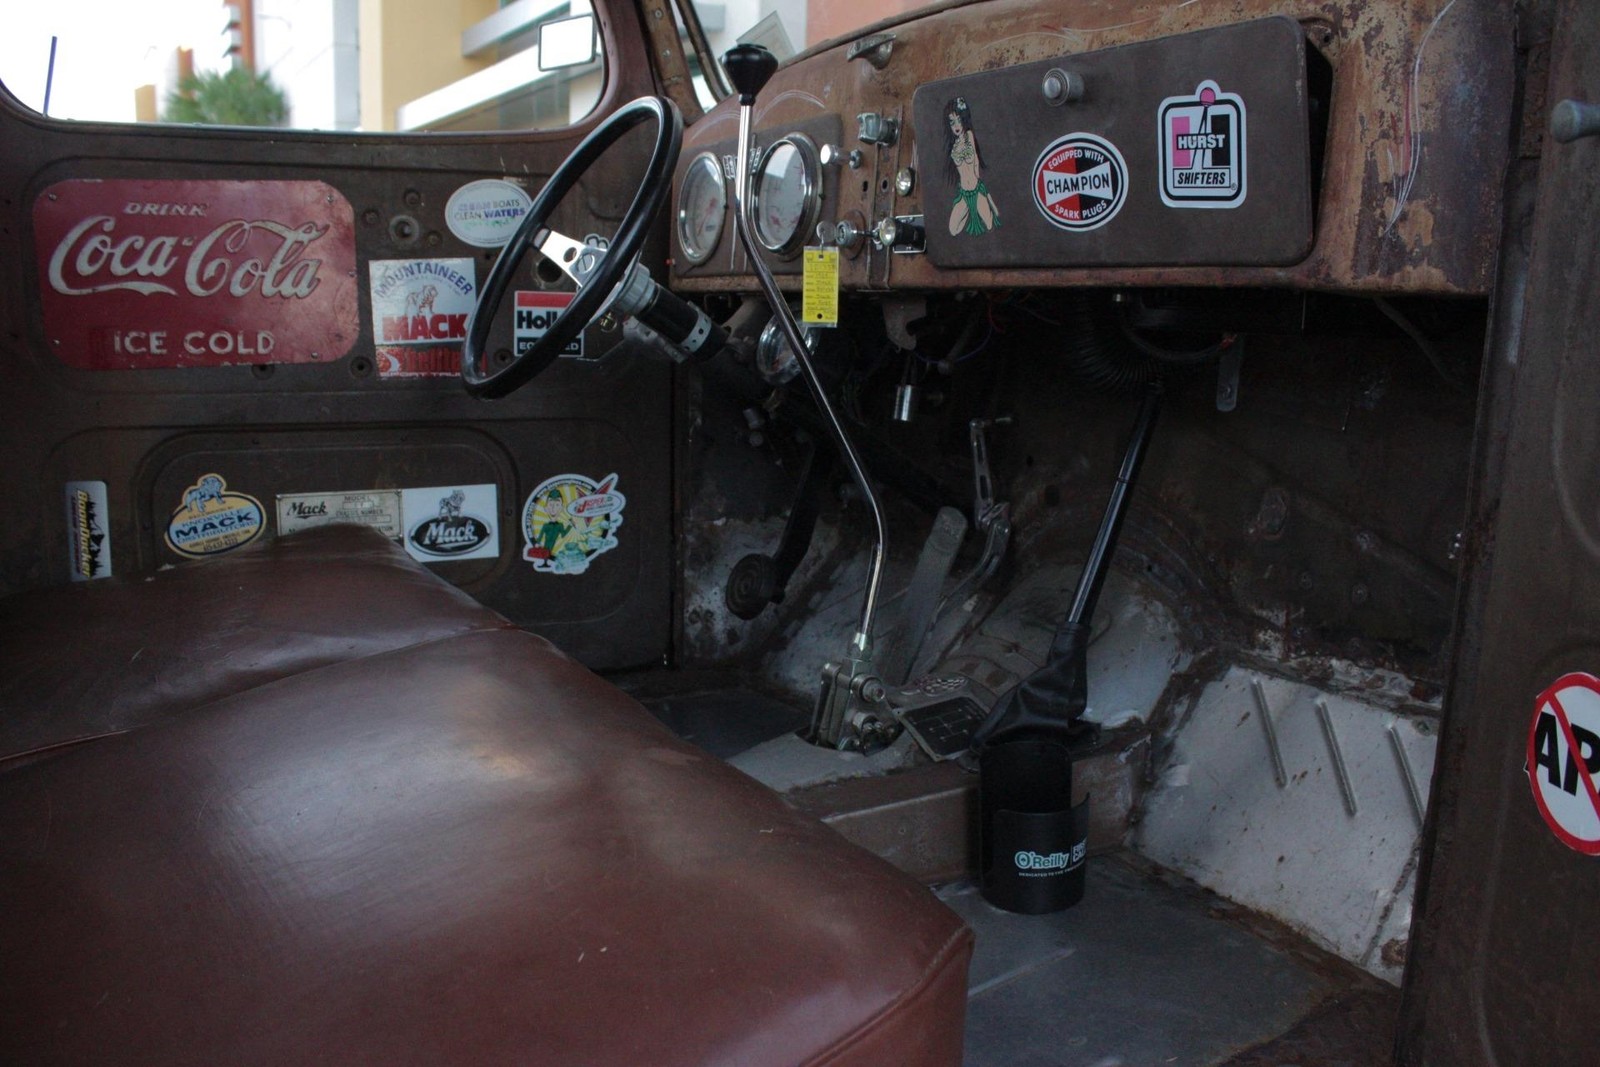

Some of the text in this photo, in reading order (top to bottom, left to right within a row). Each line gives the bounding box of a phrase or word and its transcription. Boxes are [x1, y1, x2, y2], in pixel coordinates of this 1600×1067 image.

[1177, 133, 1226, 150] HURST
[1047, 148, 1106, 170] EQUIPPED WITH
[1046, 172, 1110, 194] CHAMPION
[1177, 171, 1227, 186] SHIFTERS
[123, 202, 208, 217] DRINK
[483, 207, 526, 219] WATERS
[492, 198, 520, 209] BOATS
[1054, 200, 1109, 220] SPARK PLUGS
[374, 260, 474, 299] MOUNTAINEER
[382, 313, 469, 342] MACK
[516, 310, 558, 330] Holl
[113, 330, 276, 355] ICE COLD
[286, 501, 329, 520] Mack
[174, 511, 255, 539] MACK
[423, 522, 479, 547] Mack
[1014, 850, 1070, 870] O'Reilly
